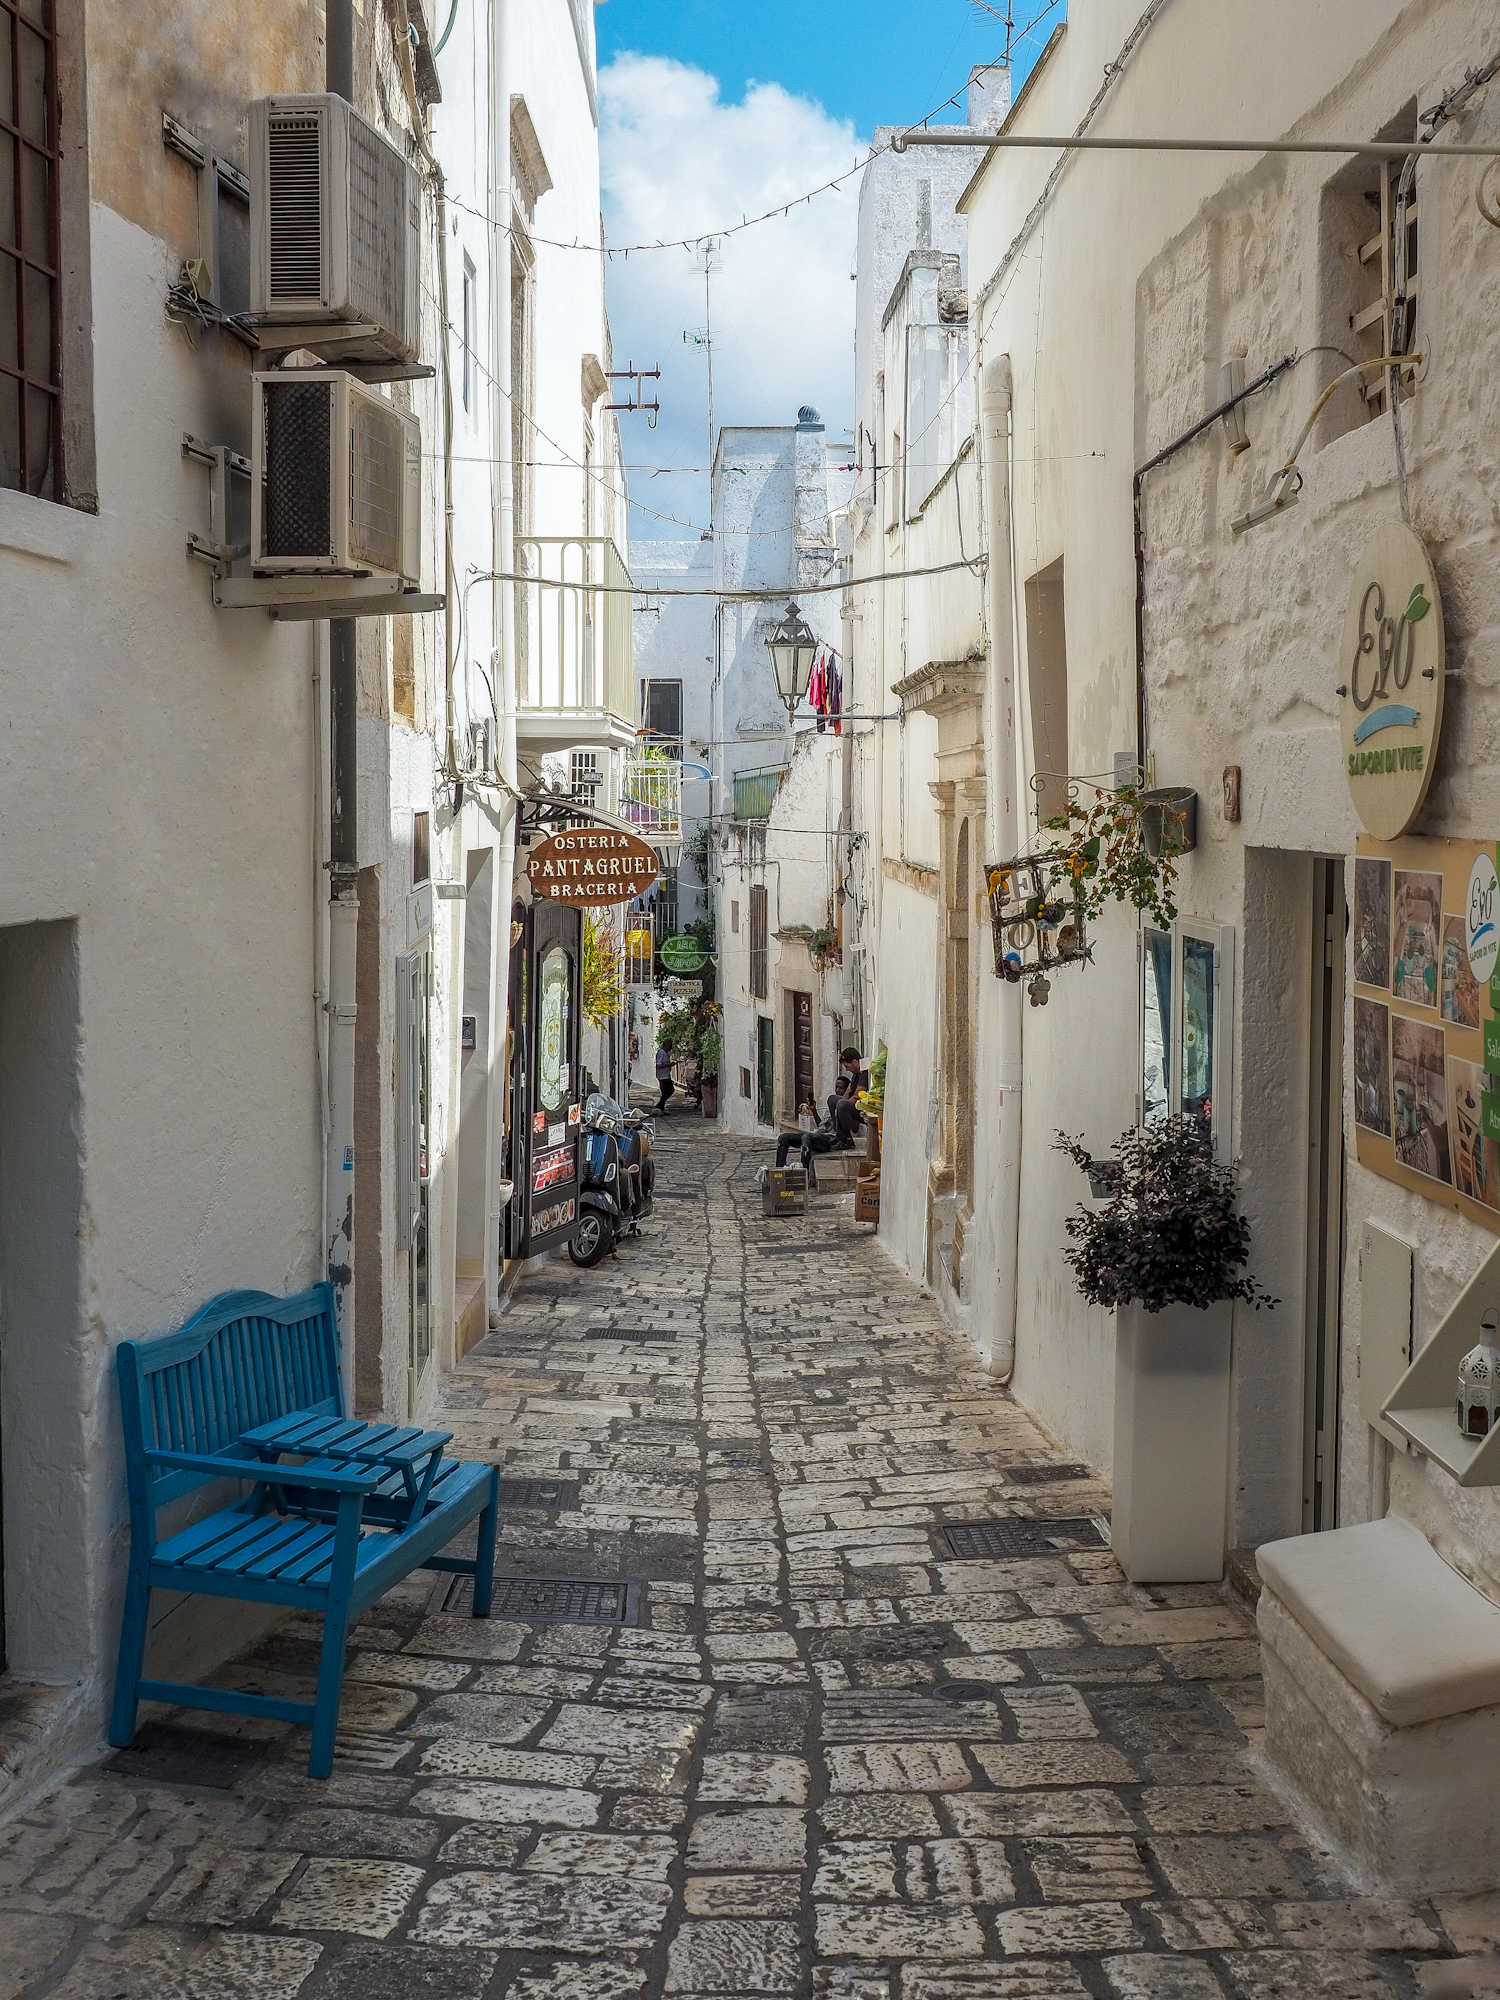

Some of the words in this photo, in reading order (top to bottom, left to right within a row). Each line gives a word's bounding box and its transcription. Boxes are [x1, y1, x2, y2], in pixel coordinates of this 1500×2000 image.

[406, 438, 419, 459] beko
[1349, 751, 1384, 776] SAPORI
[1386, 748, 1397, 772] DI
[1397, 745, 1424, 770] VITE
[554, 835, 630, 850] OSTERIA
[529, 856, 657, 877] PANTAGRUEL
[549, 882, 637, 897] BRACERIA
